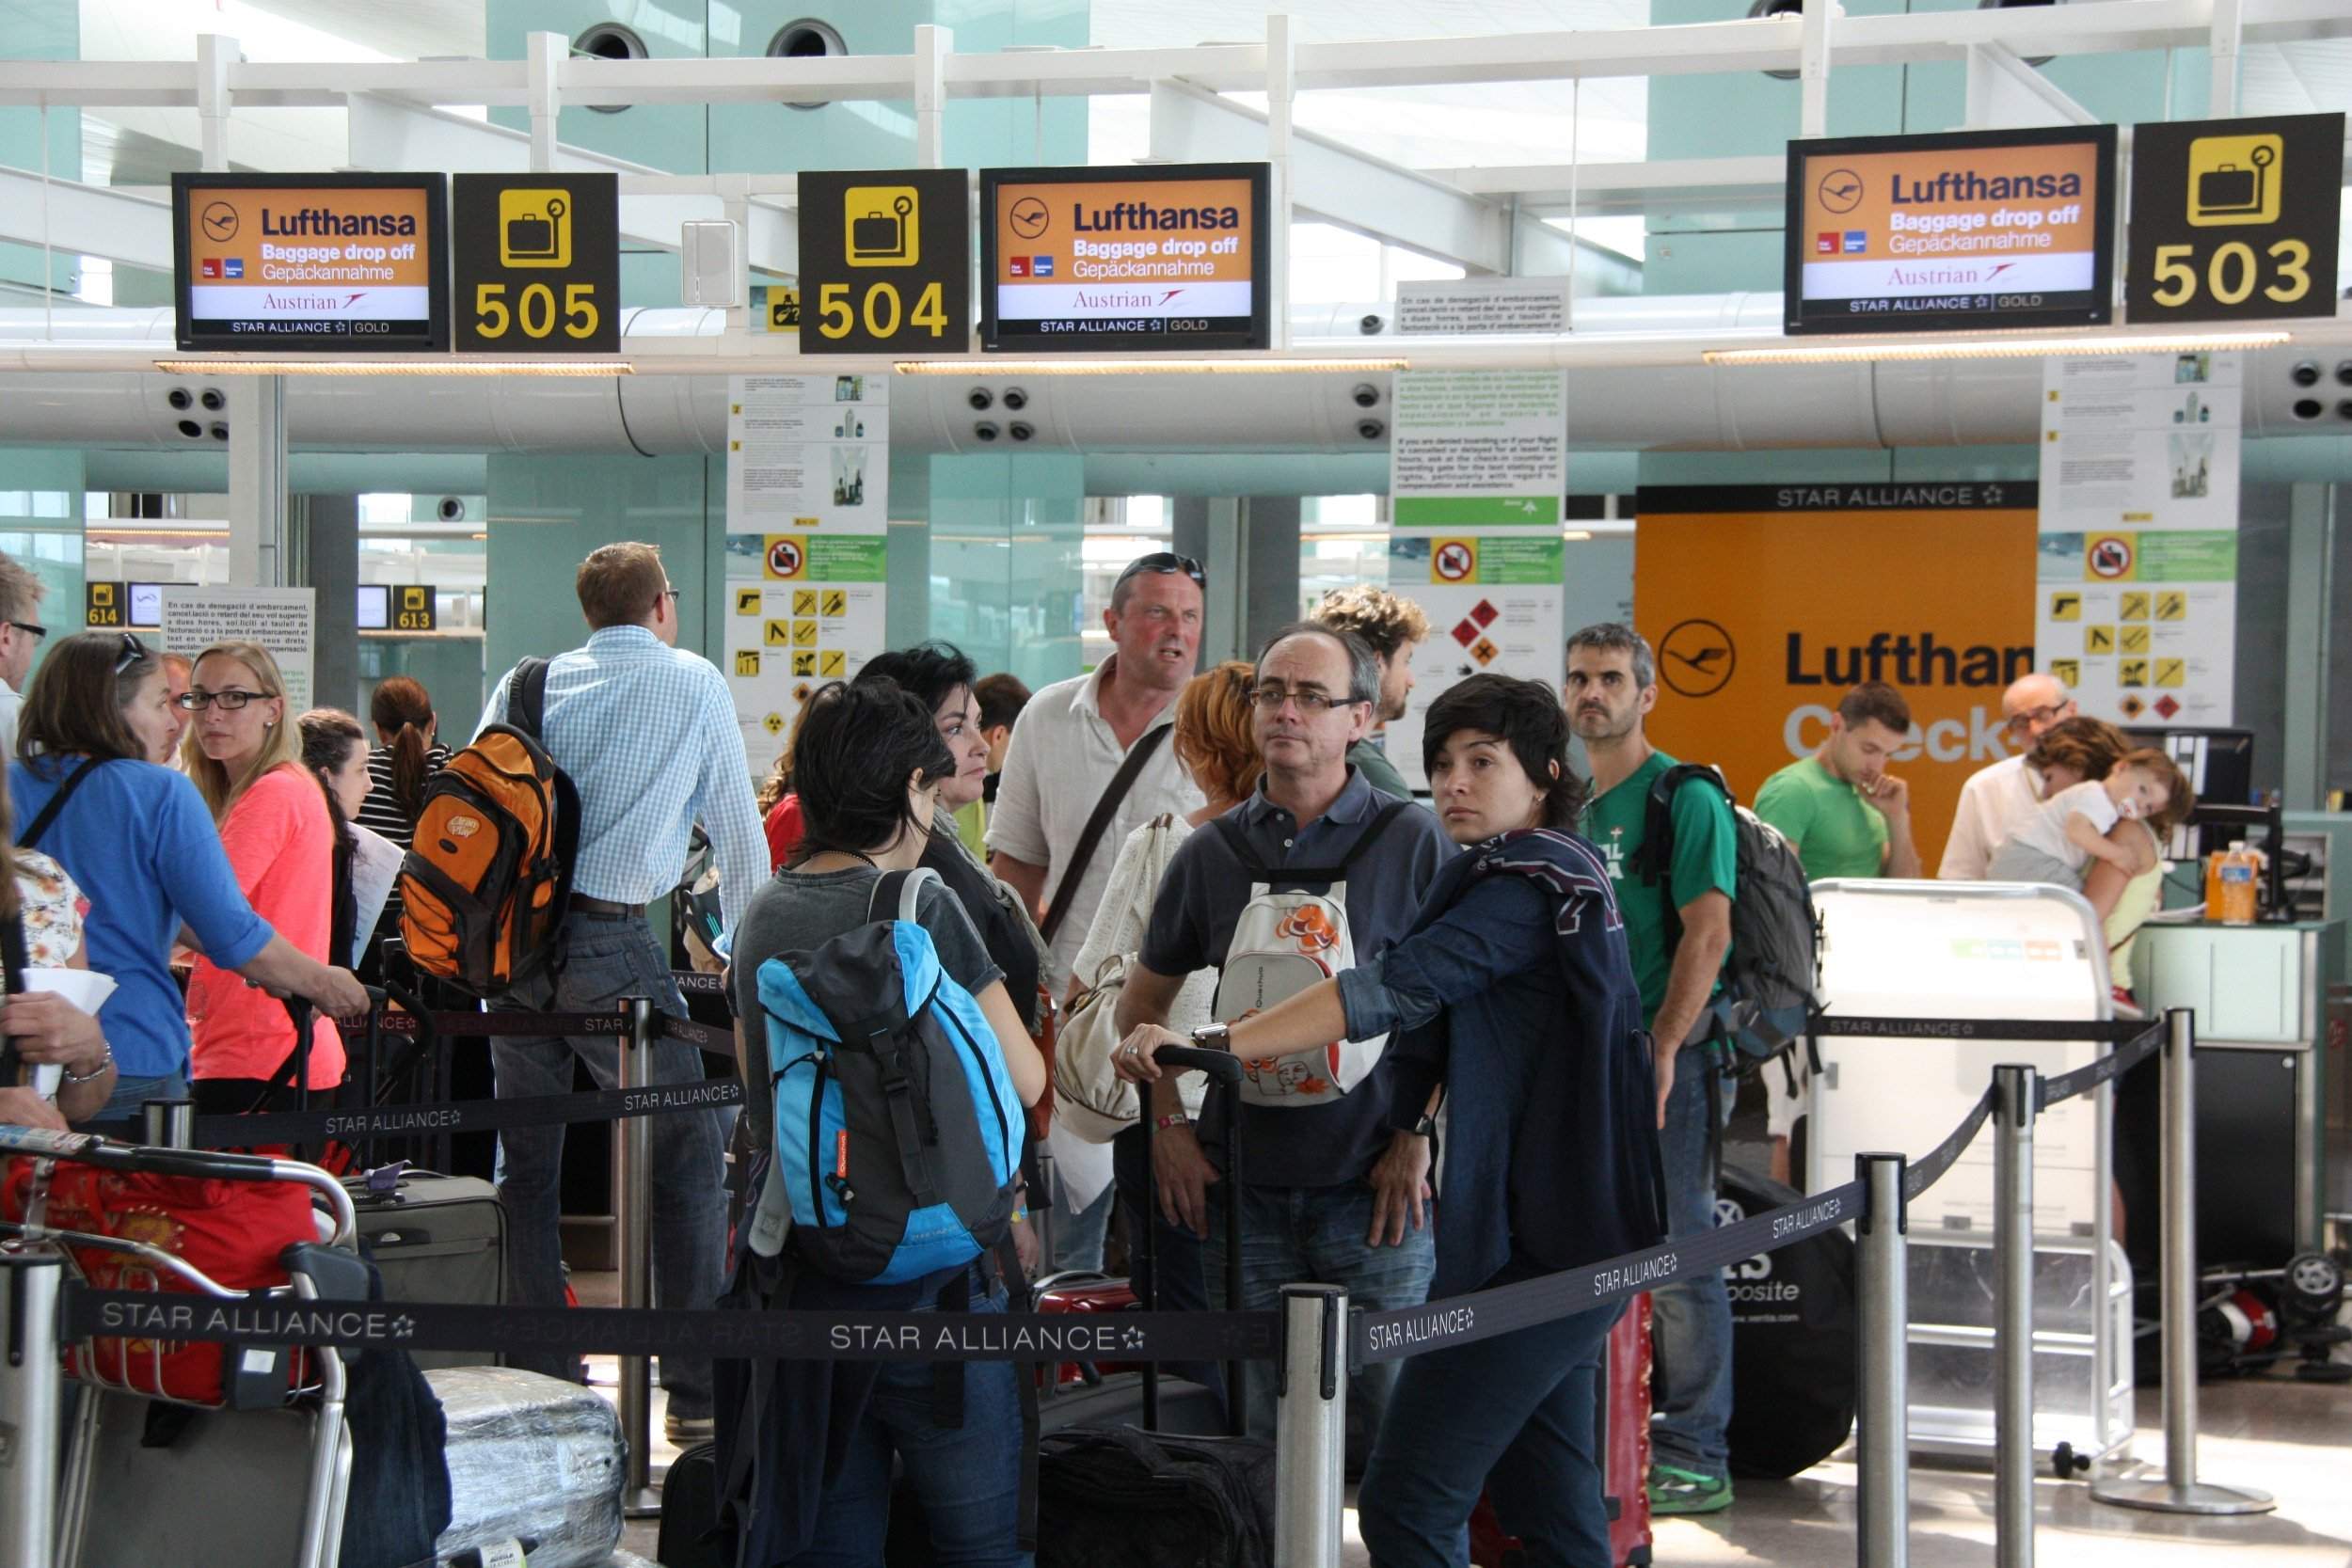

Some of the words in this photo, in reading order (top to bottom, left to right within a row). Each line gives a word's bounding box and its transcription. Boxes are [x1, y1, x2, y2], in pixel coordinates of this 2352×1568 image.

[1892, 169, 2081, 205] Lufthansa
[262, 208, 416, 235] Lufthansa
[1073, 201, 1240, 232] Lufthansa
[1890, 209, 1985, 234] Baggage
[1990, 207, 2040, 230] drop
[2047, 203, 2080, 225] off
[262, 244, 342, 262] Baggage
[345, 244, 387, 262] drop
[390, 243, 416, 261] off
[1073, 237, 1160, 259] Baggage
[1163, 237, 1207, 258] drop
[1210, 235, 1239, 255] off
[1889, 231, 2052, 255] Gepäckannahme
[262, 263, 394, 282] Gepäckannahme
[1073, 259, 1216, 280] Gepäckannahme
[1886, 264, 1978, 287] Austrian
[2152, 238, 2311, 308] 503
[262, 293, 337, 310] Austrian
[475, 282, 599, 339] 505
[1073, 289, 1152, 309] Austrian
[1850, 298, 1891, 313] STAR
[1892, 295, 1970, 311] ALLIANCE
[1997, 294, 2042, 308] GOLD
[818, 282, 948, 341] 504
[232, 322, 264, 333] STAR
[266, 322, 331, 334] ALLIANCE
[355, 322, 389, 334] GOLD
[1040, 321, 1073, 333] STAR
[1074, 320, 1146, 333] ALLIANCE
[1170, 319, 1209, 332] GOLD
[1777, 488, 1839, 508] STAR
[1847, 485, 1974, 506] ALLIANCE
[88, 608, 119, 625] 614
[399, 612, 430, 628] 613
[584, 1017, 624, 1033] STAR
[1829, 1020, 1872, 1035] STAR
[1877, 1021, 1961, 1037] ALLIANCE
[625, 1092, 659, 1112] STAR
[662, 1085, 731, 1107] ALLIANCE
[326, 1116, 367, 1135] STAR
[370, 1110, 449, 1132] ALLIANCE
[1772, 1216, 1796, 1240] STAR
[1793, 1199, 1836, 1234] ALLIANCE
[1594, 1272, 1622, 1297] STAR
[1622, 1256, 1672, 1290] ALLIANCE
[102, 1302, 193, 1330] STAR
[205, 1307, 388, 1338] ALLIANCE
[1370, 1320, 1405, 1352] STAR
[1405, 1307, 1468, 1343] ALLIANCE
[829, 1324, 921, 1351] STAR
[934, 1325, 1118, 1352] ALLIANCE
